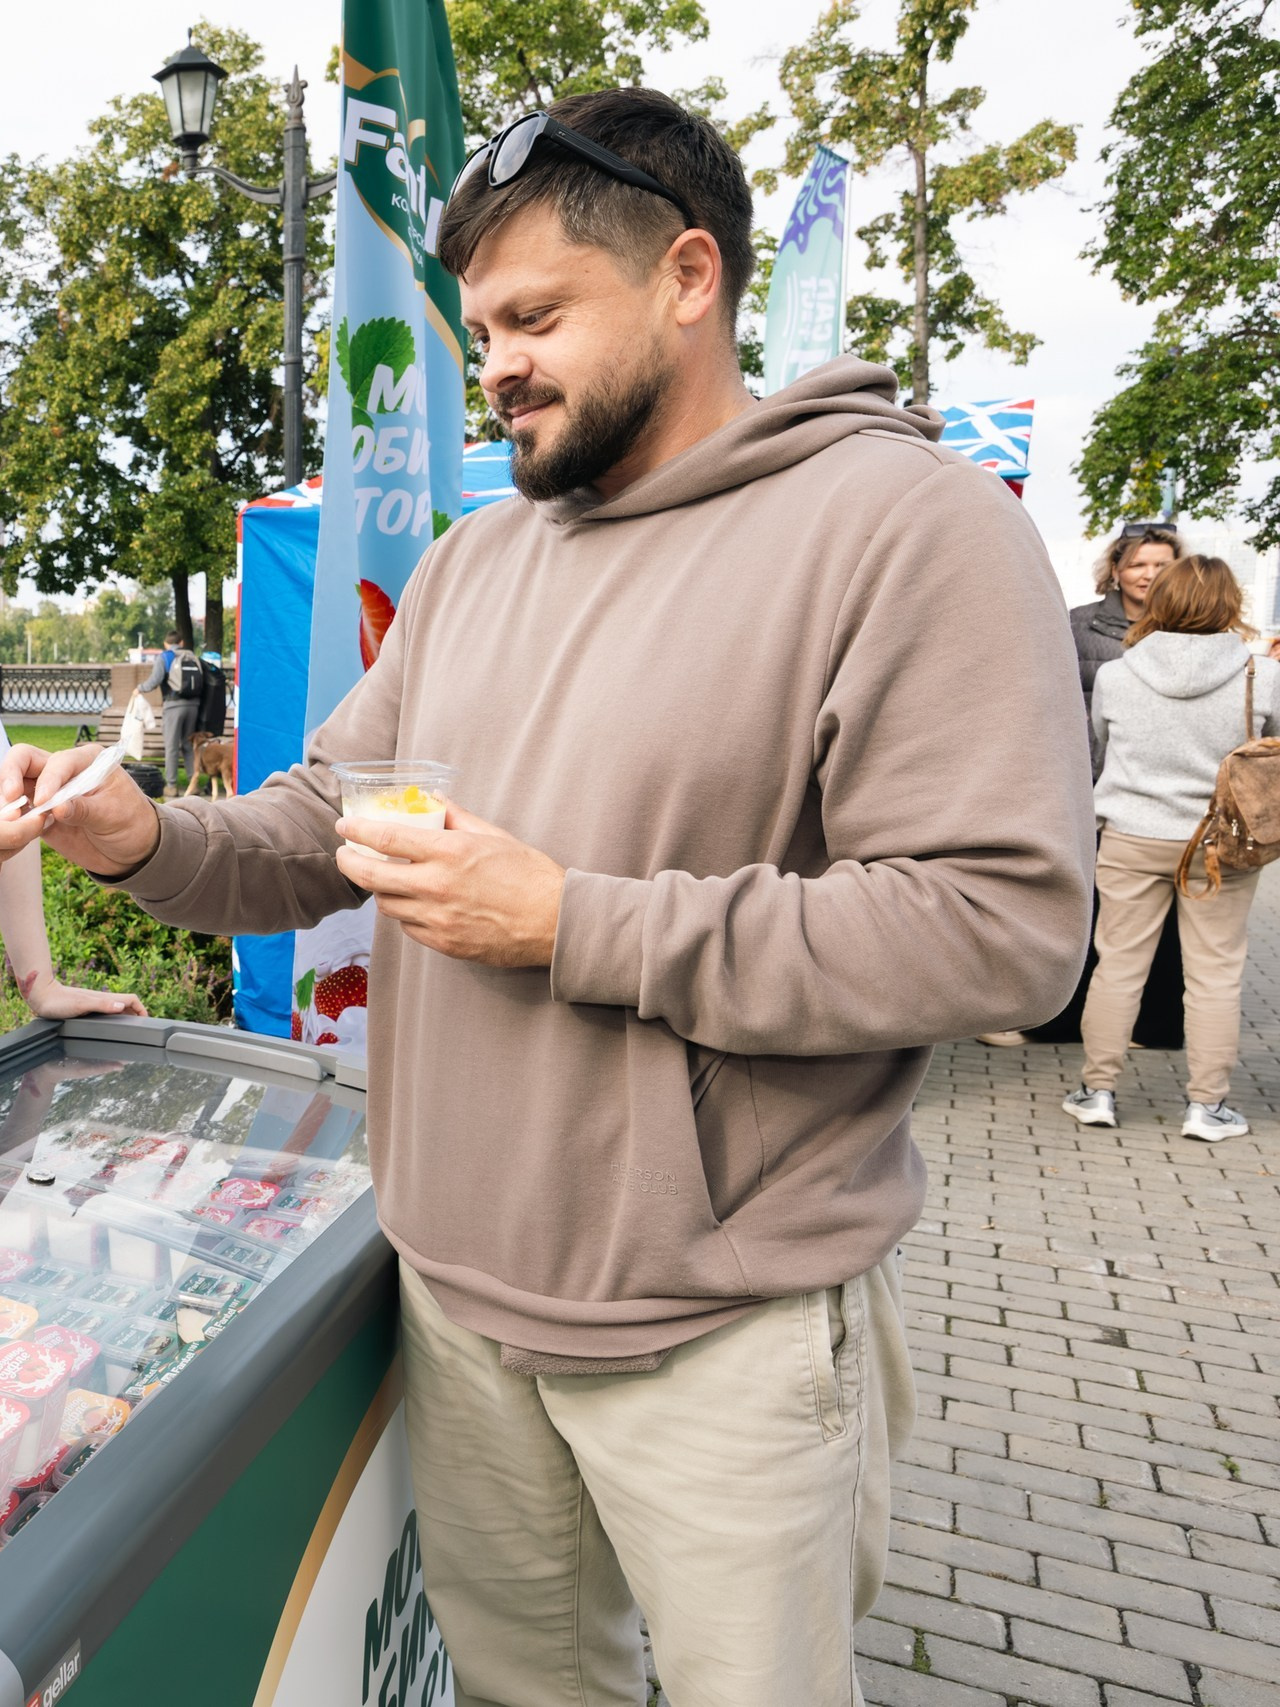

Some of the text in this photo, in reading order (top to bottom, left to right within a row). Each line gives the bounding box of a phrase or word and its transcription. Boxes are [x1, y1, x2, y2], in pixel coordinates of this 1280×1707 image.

[214, 1308, 238, 1328] Fantel
[171, 1352, 196, 1374] Fantel
[362, 1509, 421, 1706] МО
[43, 1652, 80, 1707] gellar
